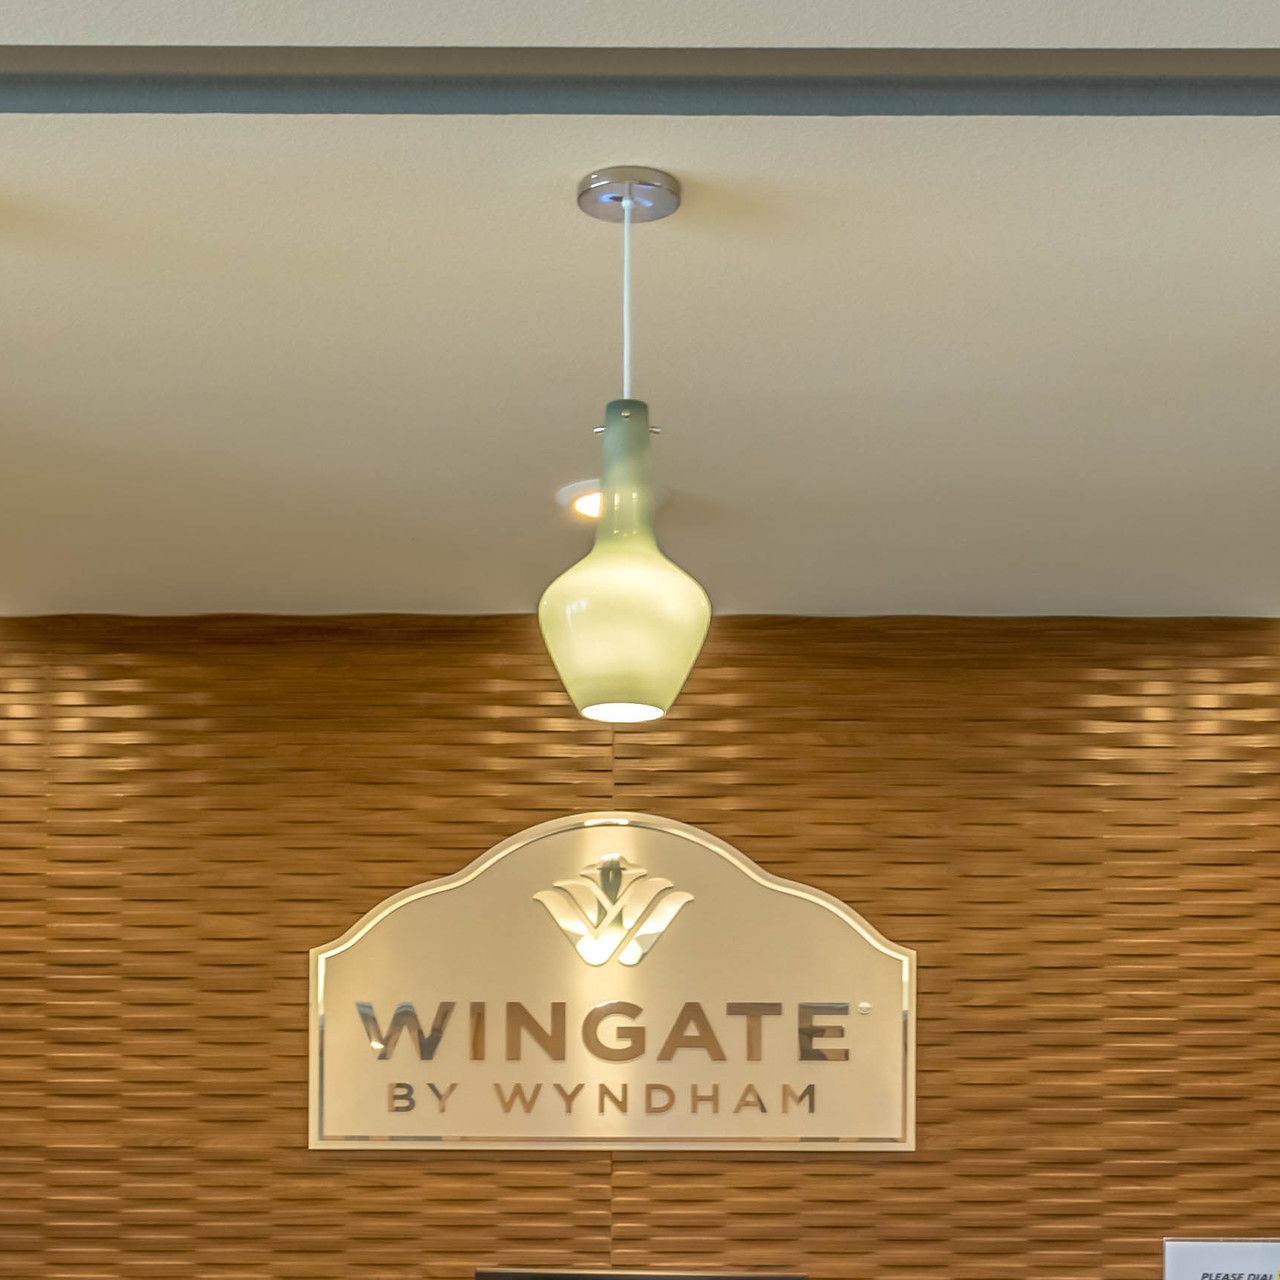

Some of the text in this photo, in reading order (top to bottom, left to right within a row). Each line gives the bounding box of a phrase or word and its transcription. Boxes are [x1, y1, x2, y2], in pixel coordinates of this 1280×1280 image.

[355, 1000, 851, 1064] WINGATE
[387, 1082, 817, 1114] BY WYNDHAM
